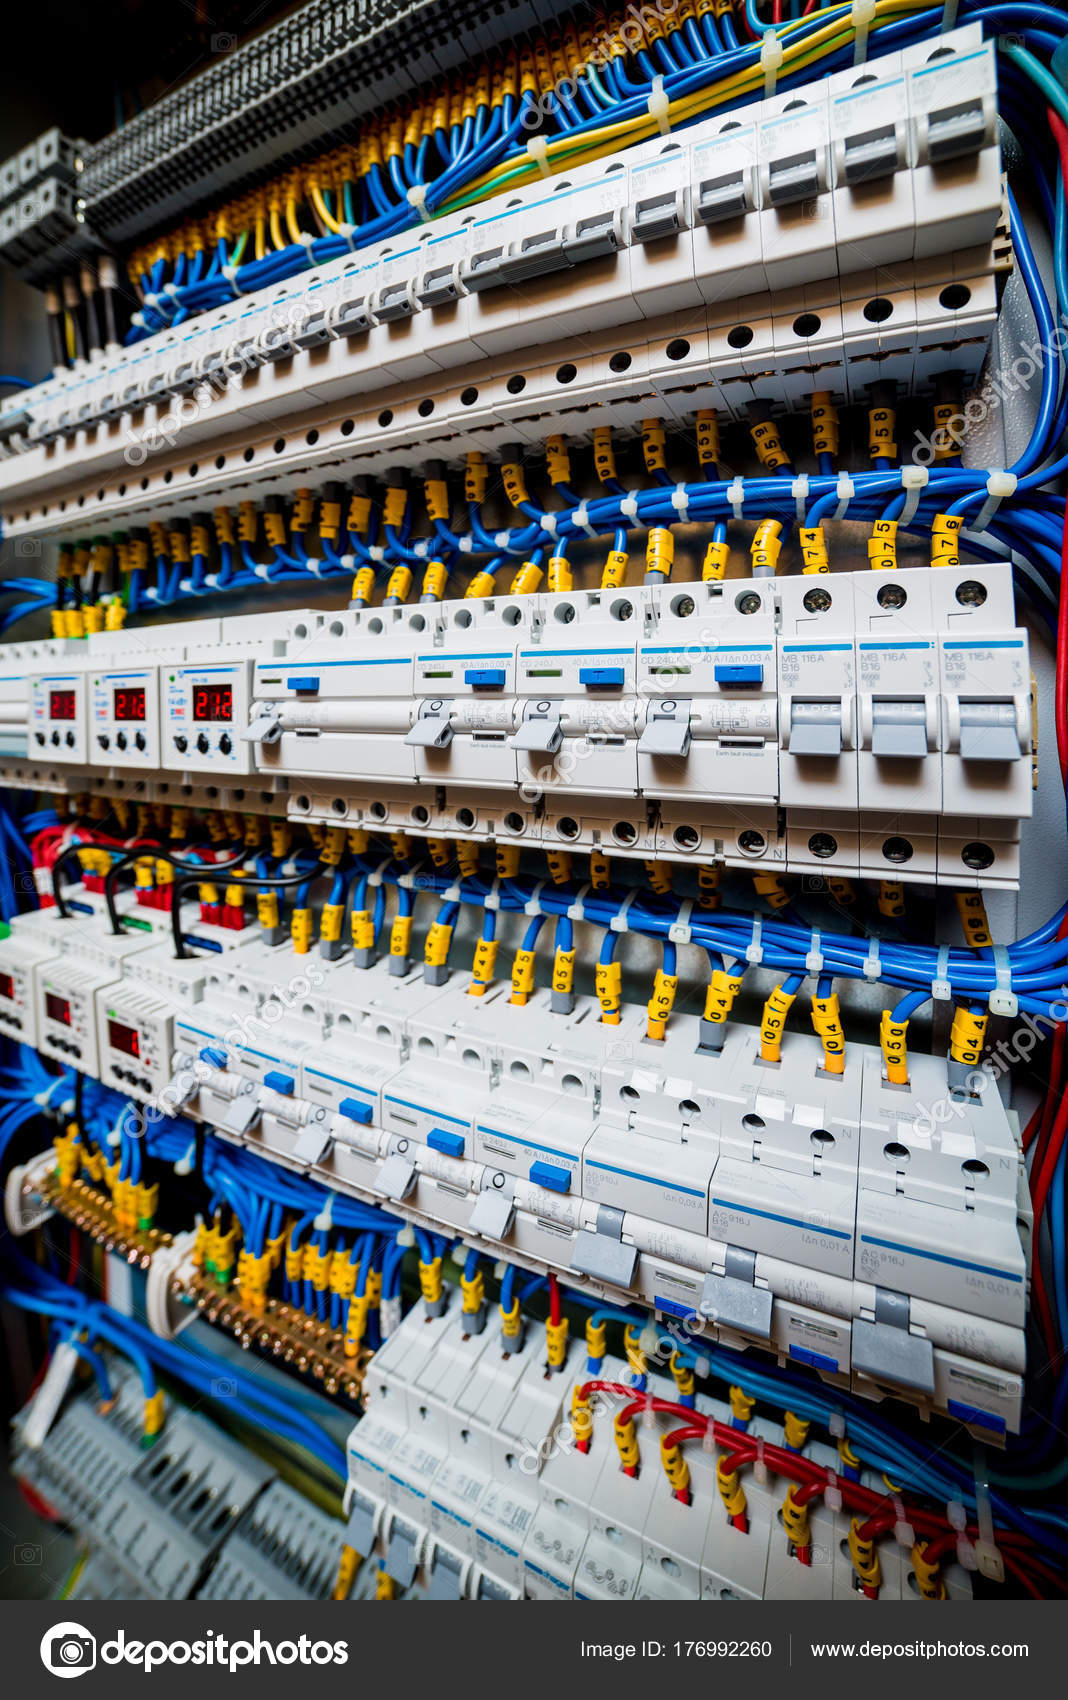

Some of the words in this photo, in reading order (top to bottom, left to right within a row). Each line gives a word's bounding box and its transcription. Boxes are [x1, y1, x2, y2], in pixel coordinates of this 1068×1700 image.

[806, 531, 829, 574] 074
[942, 519, 960, 567] 076
[196, 691, 233, 718] 212
[556, 955, 573, 990] 052
[599, 969, 612, 1007] 043
[657, 979, 678, 1019] 052
[710, 983, 741, 1020] 043
[763, 995, 787, 1040] 051
[817, 1003, 840, 1049] 044
[887, 1027, 905, 1065] 050
[961, 1019, 985, 1062] 044
